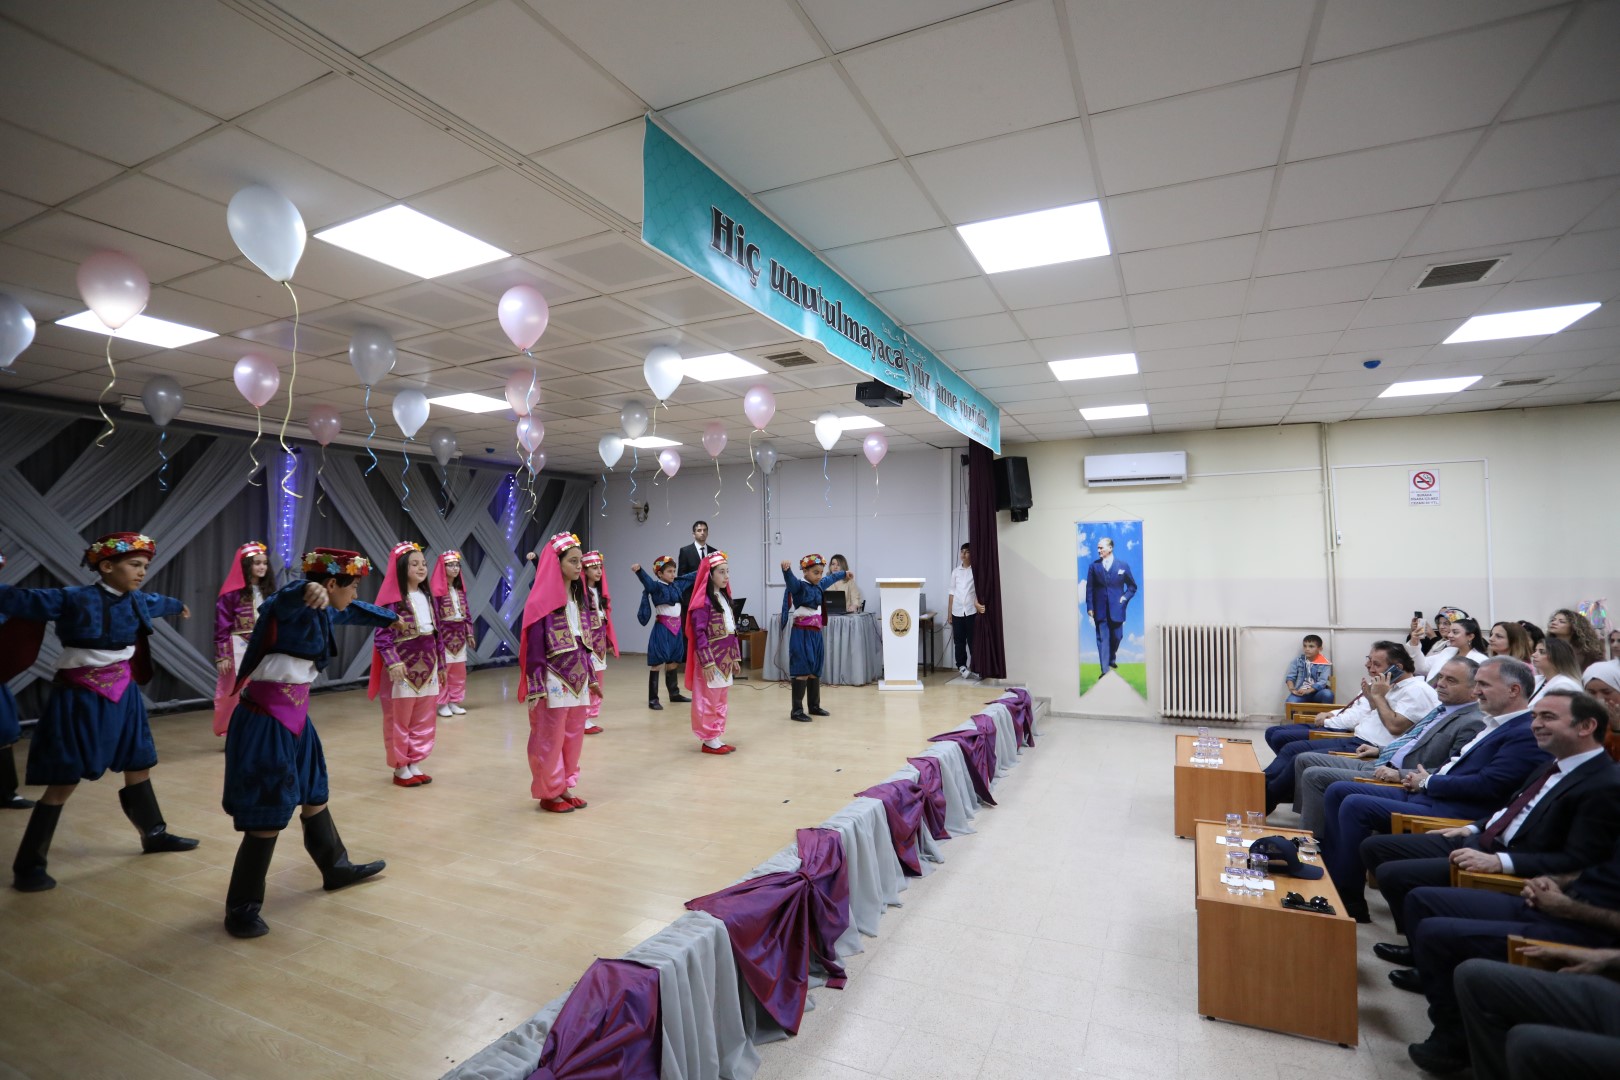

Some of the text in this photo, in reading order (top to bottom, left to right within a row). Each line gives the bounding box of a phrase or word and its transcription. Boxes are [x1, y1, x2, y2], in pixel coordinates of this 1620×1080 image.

[710, 205, 761, 288] Hiç
[769, 257, 911, 377] unutulmayacak
[936, 381, 958, 412] anne
